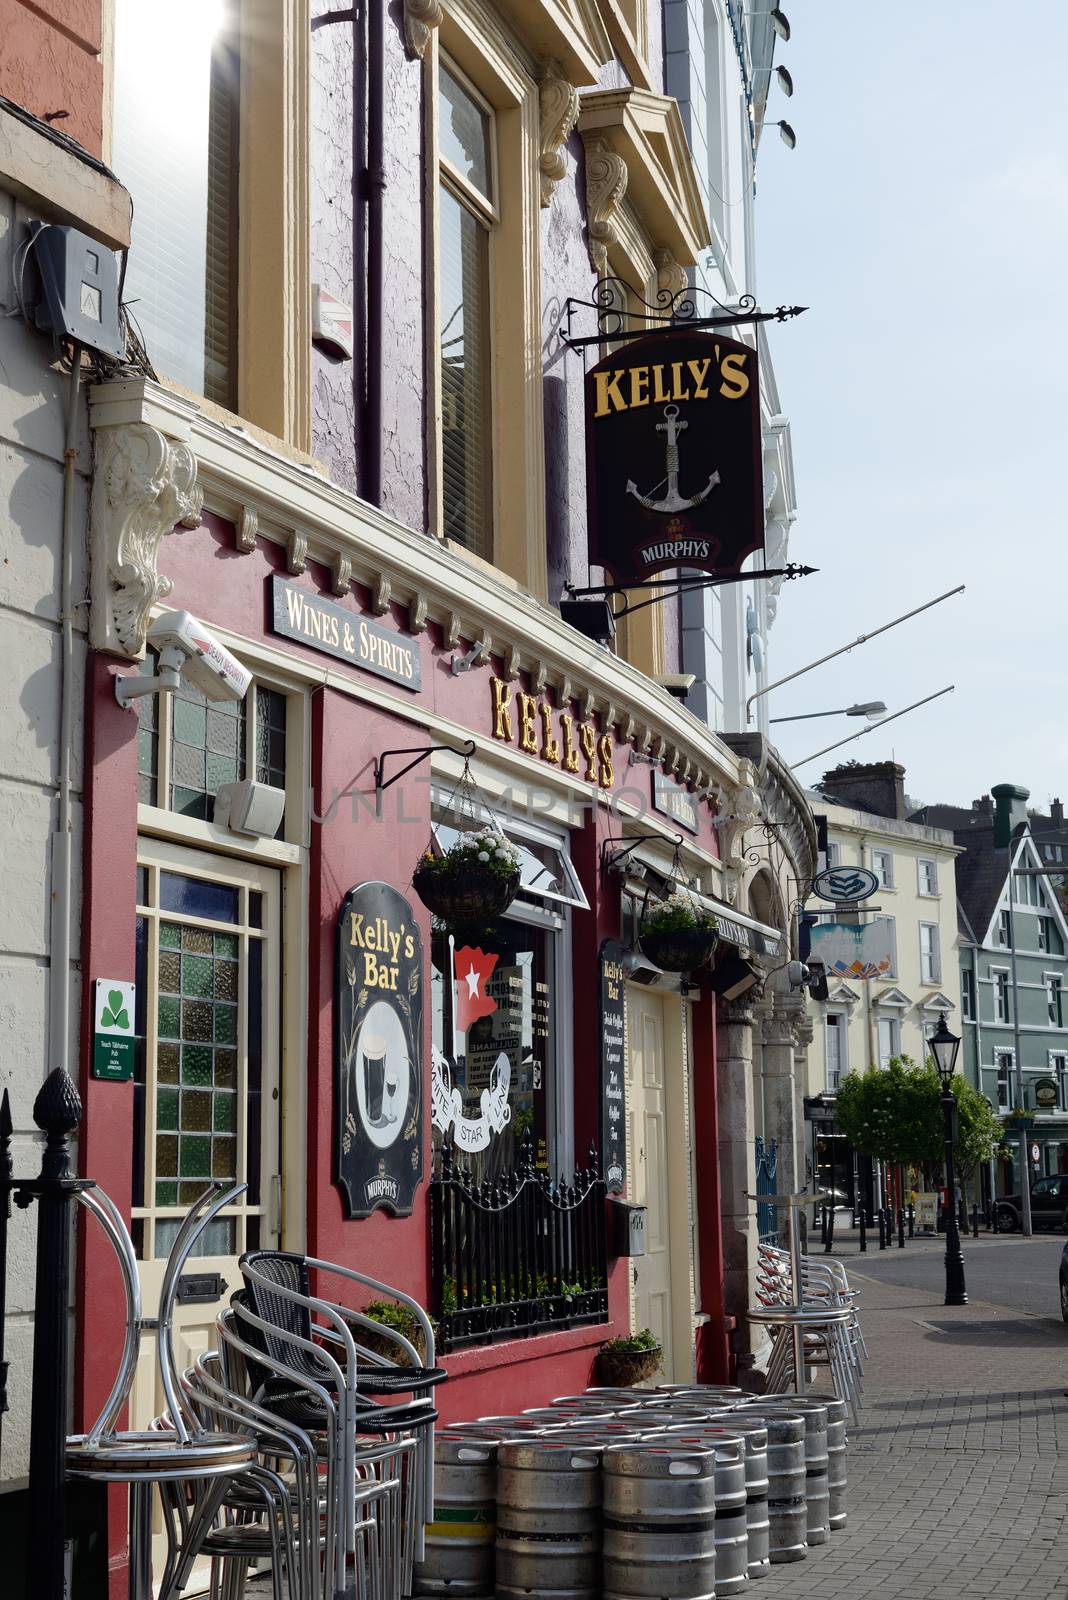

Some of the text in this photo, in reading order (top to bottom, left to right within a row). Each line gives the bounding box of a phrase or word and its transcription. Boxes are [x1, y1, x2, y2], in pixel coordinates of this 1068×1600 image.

[593, 344, 750, 418] KELLY'S
[641, 540, 710, 564] MURPHY'S
[285, 588, 413, 680] WINES & SPIRITS
[489, 675, 615, 789] KELLYS
[350, 911, 414, 963] Kelly's
[363, 952, 399, 990] Bar
[604, 960, 623, 984] Kelly's
[607, 981, 619, 1001] Bar
[494, 1078, 508, 1118] LINE
[461, 1125, 483, 1143] STAR
